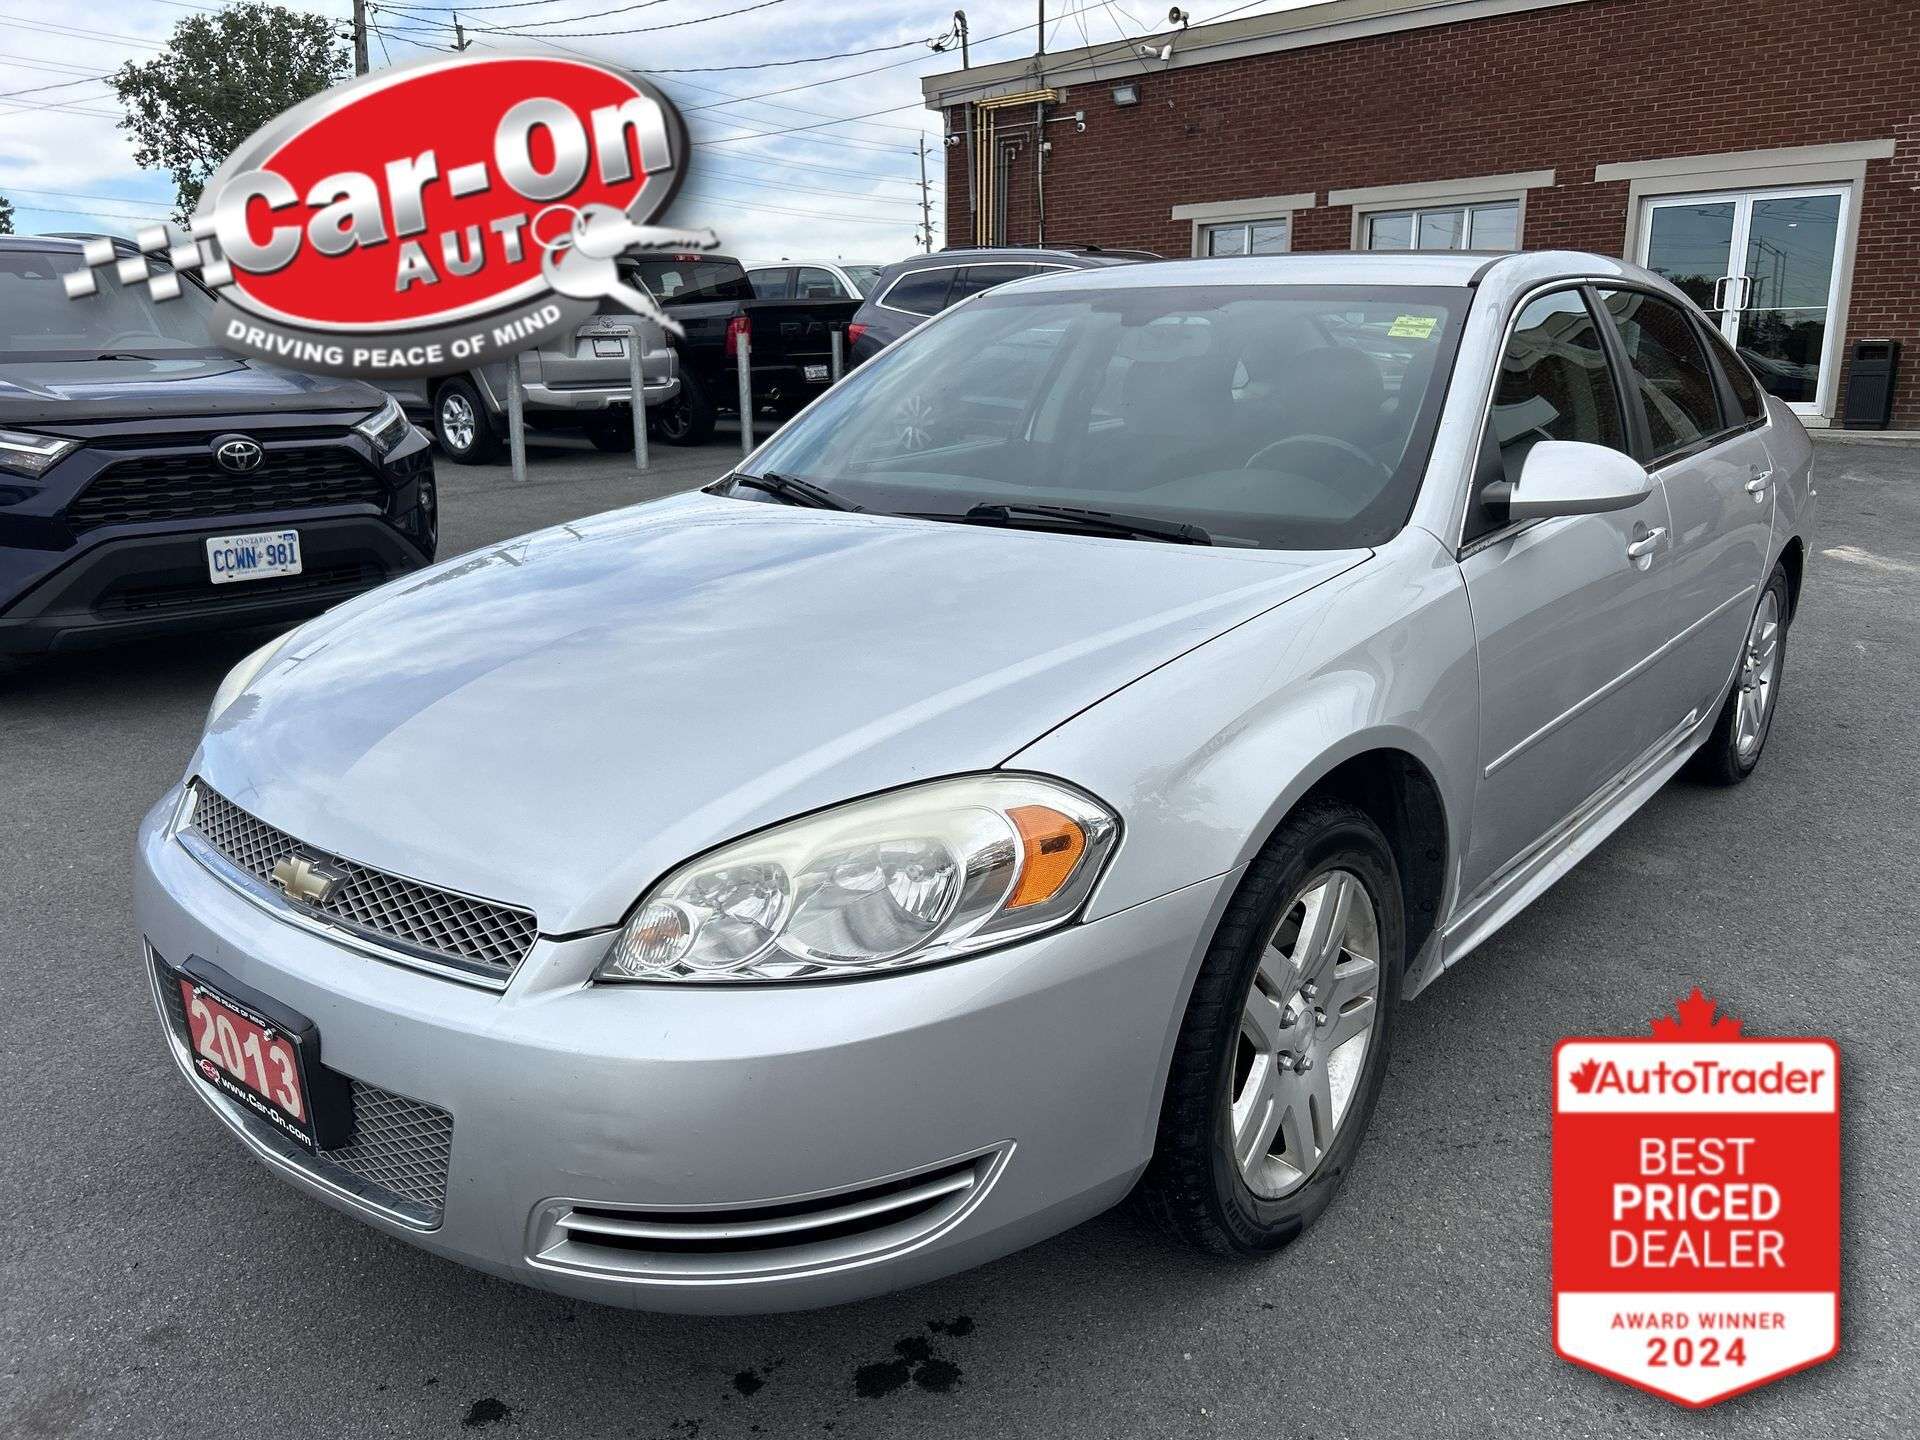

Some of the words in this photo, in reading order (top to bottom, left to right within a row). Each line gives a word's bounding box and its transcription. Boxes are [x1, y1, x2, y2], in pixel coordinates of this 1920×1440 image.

[213, 546, 257, 573] CCWN
[266, 542, 297, 567] 981
[191, 999, 301, 1118] 2013
[221, 1077, 312, 1147] www.Car-On.com
